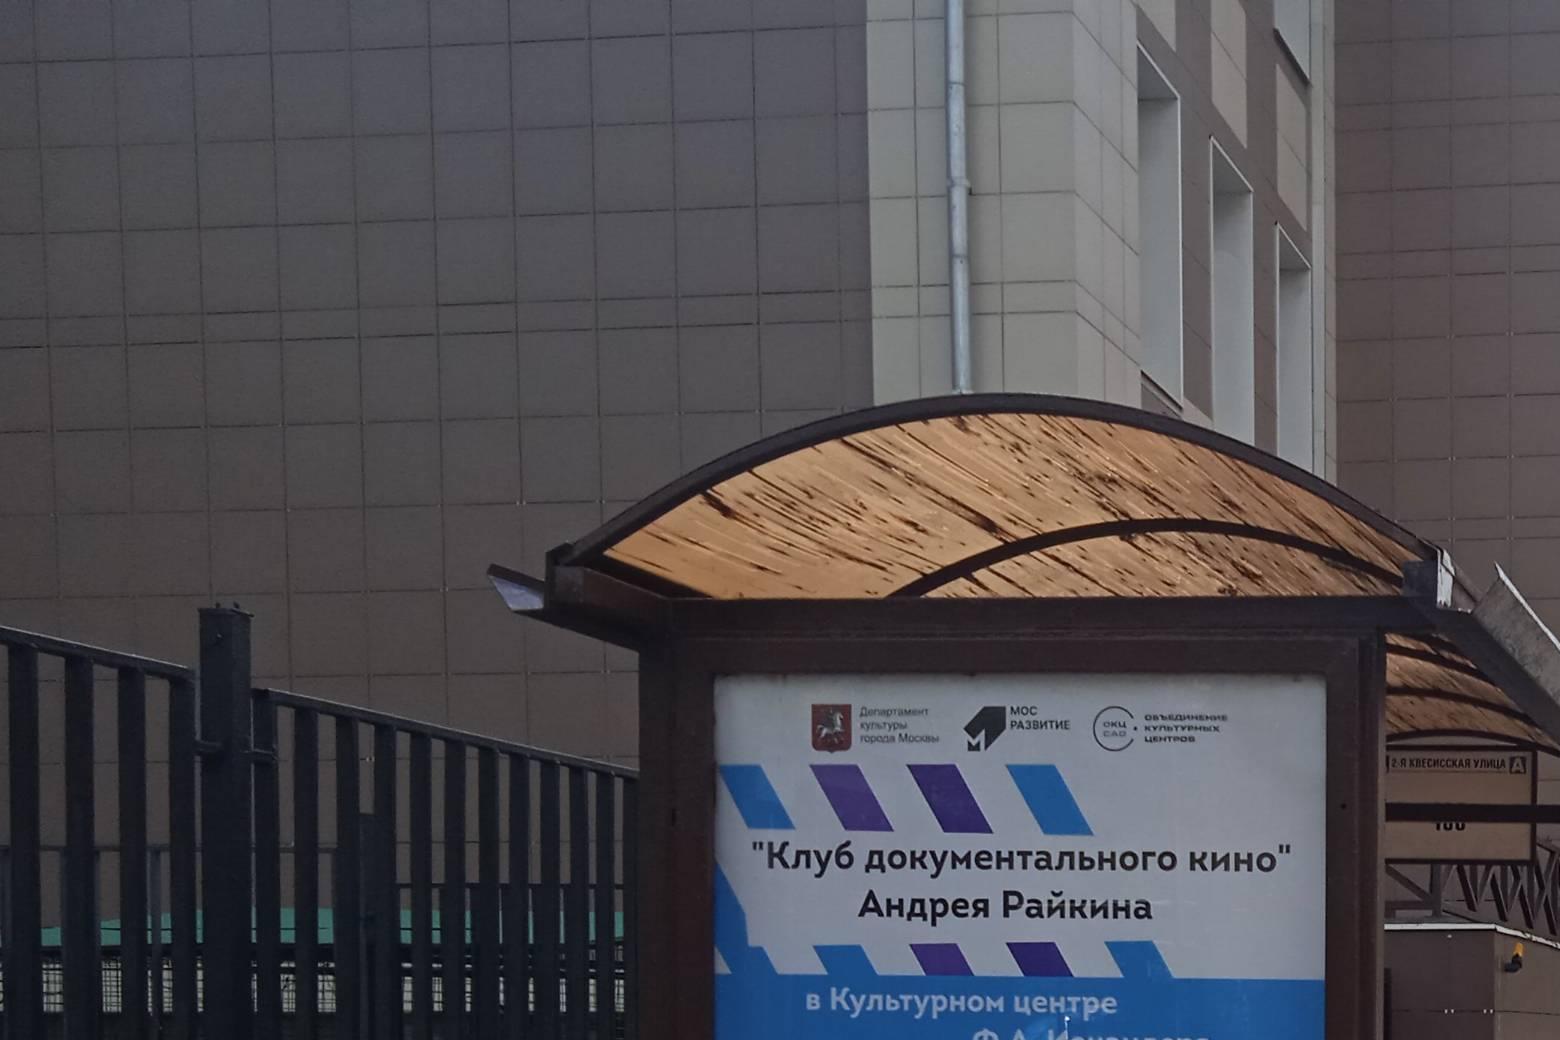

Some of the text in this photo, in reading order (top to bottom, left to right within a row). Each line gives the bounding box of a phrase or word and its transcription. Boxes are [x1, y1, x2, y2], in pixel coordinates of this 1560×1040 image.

[859, 706, 928, 718] Департамент
[1011, 706, 1037, 716] МОС
[860, 722, 907, 732] культуры
[1010, 720, 1069, 730] РАЗВИТИЕ
[860, 733, 939, 744] города Москвы
[1409, 758, 1471, 769] КВЕСИССКАЯ
[1474, 758, 1506, 770] УЛИЦА
[752, 840, 1290, 879] "Клуб документального кино"
[858, 890, 1152, 927] Андрея Райкина
[807, 987, 1117, 1019] в Культурном центре
